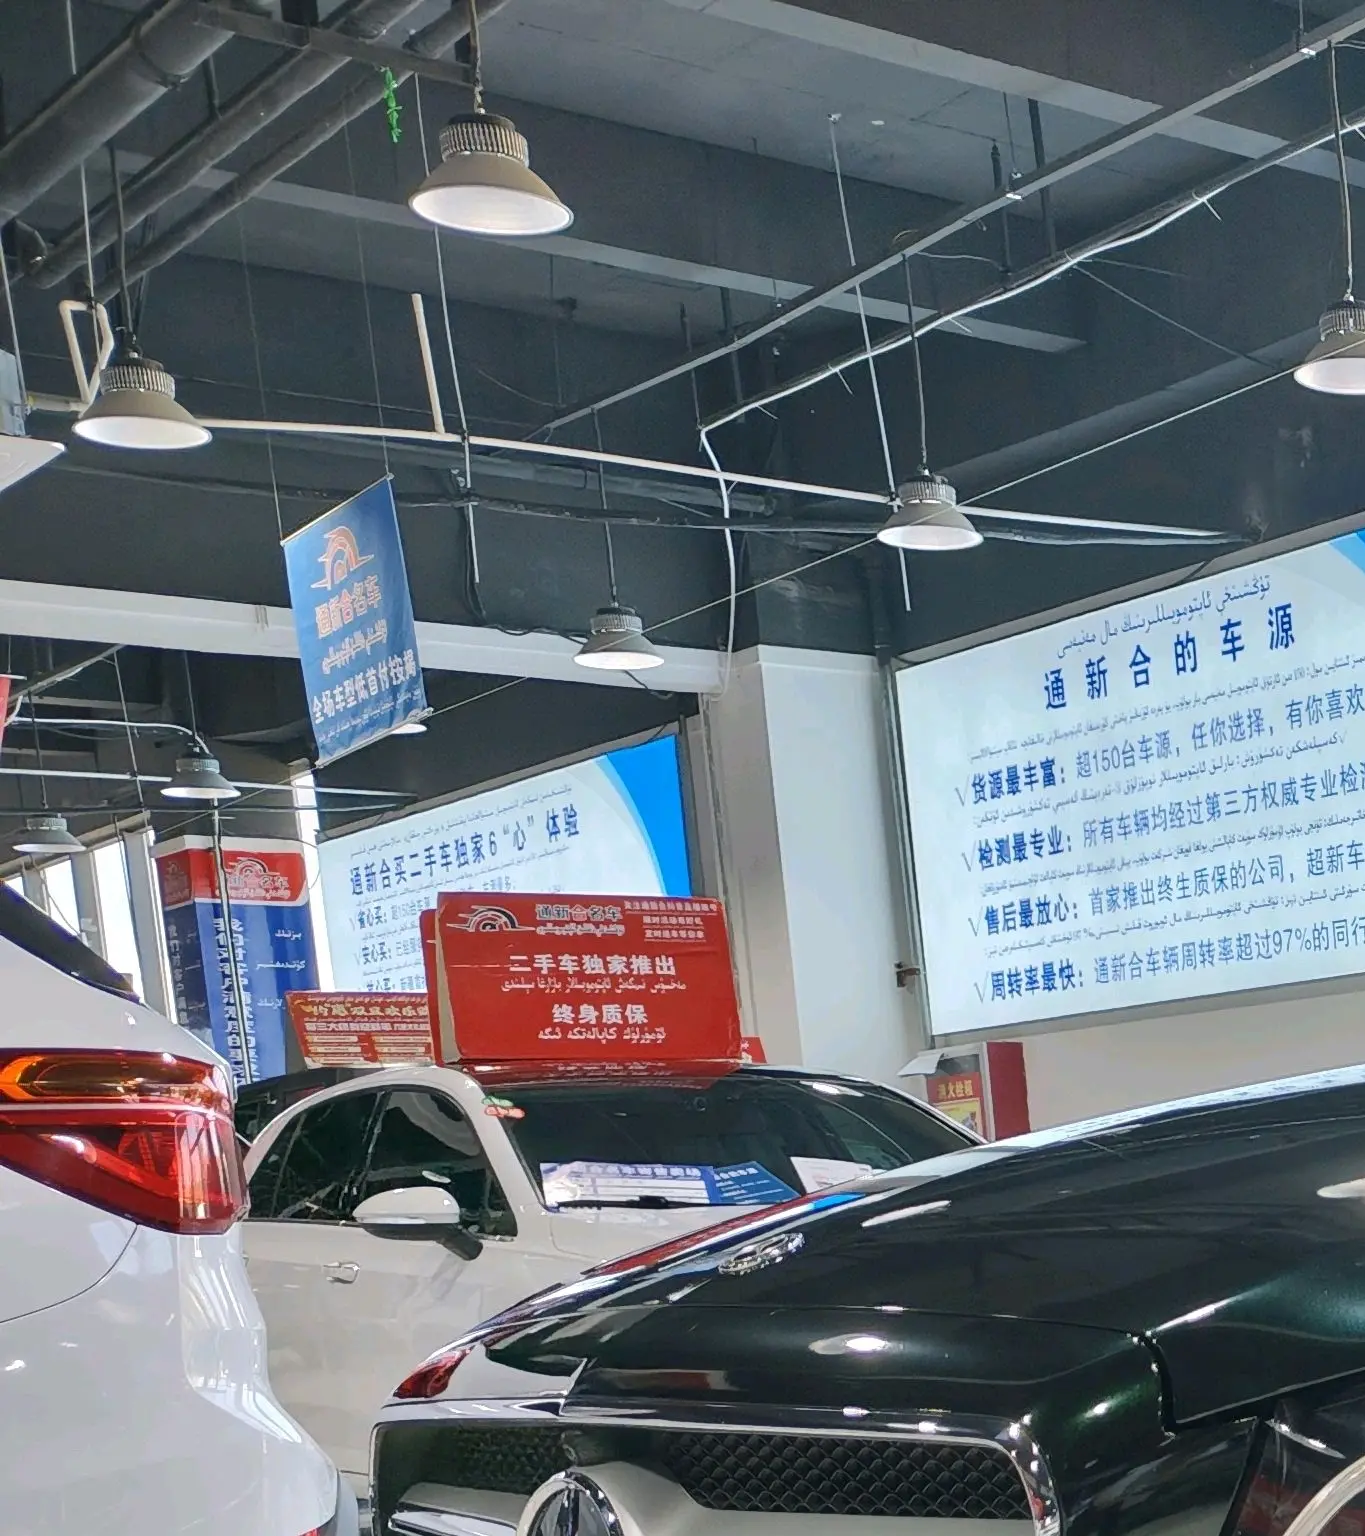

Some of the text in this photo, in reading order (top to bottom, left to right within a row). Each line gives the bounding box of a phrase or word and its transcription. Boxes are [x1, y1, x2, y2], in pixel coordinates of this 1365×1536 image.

[1044, 603, 1296, 710] 通新合的车源
[534, 904, 624, 922] 通新合名车
[508, 953, 677, 975] 二手车独家推出
[551, 1003, 649, 1025] 终身质保
